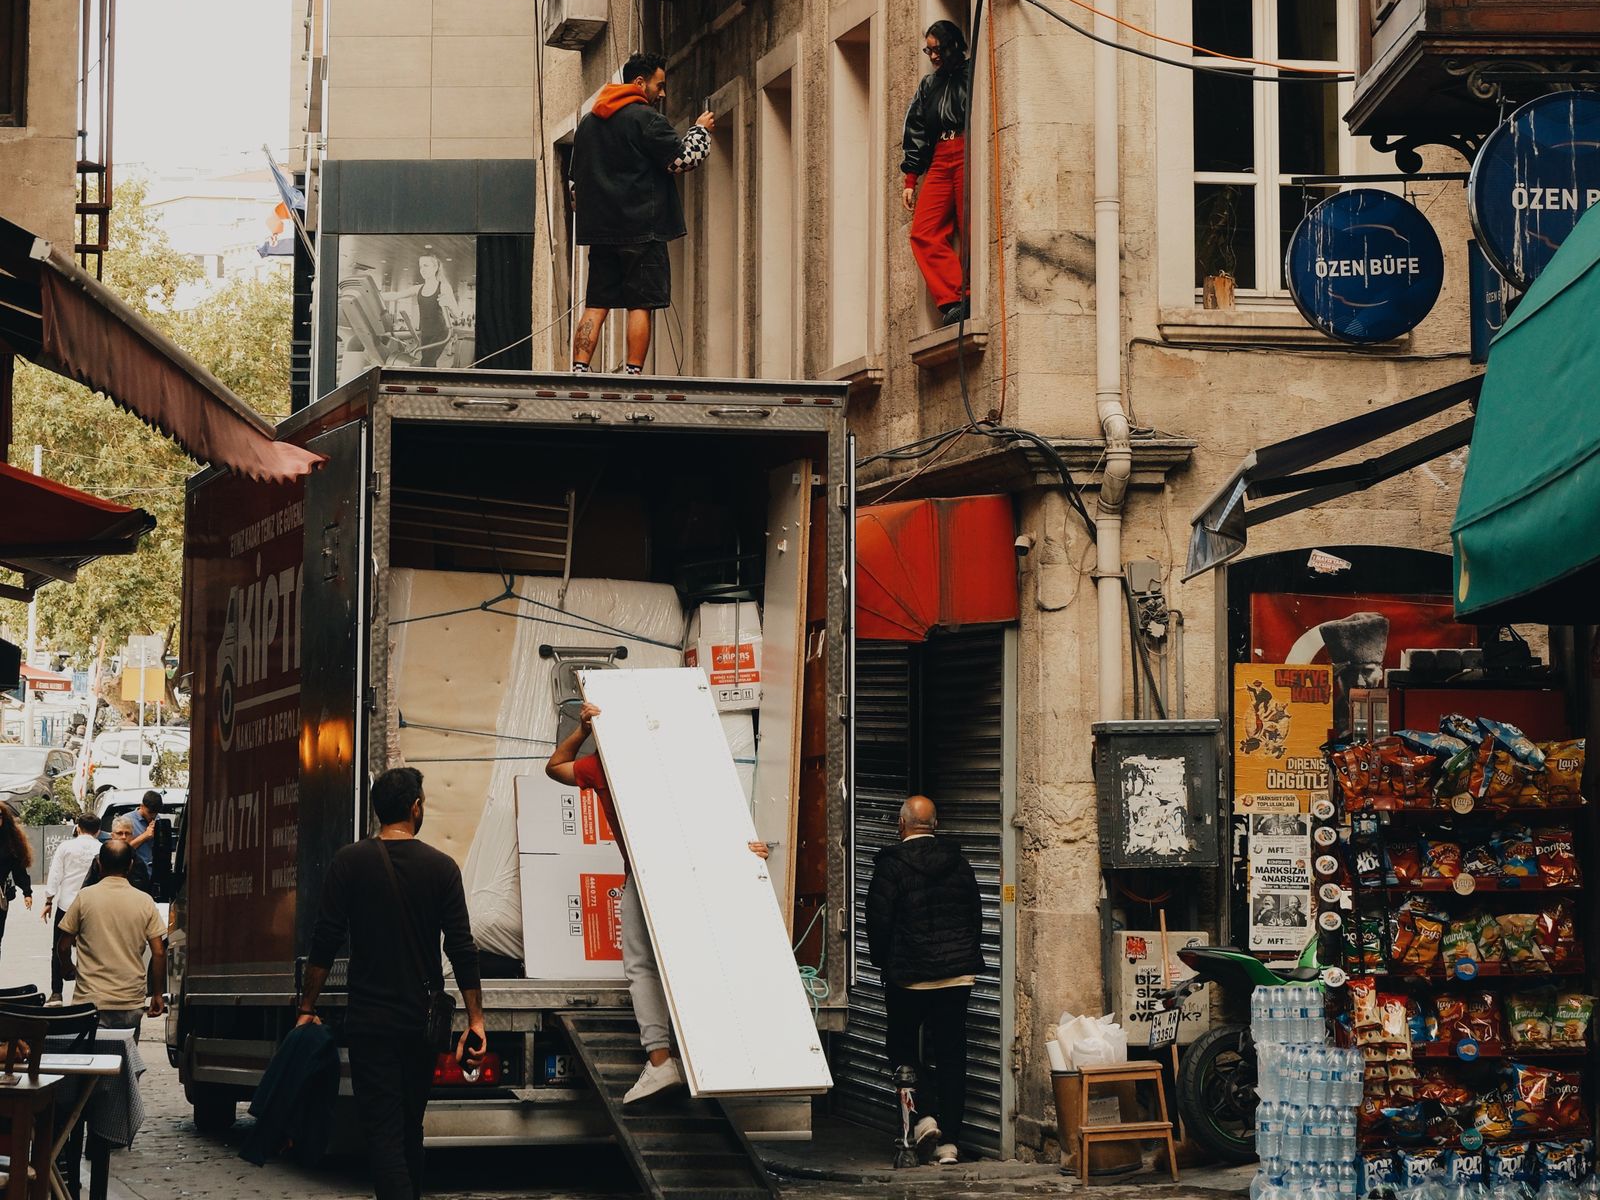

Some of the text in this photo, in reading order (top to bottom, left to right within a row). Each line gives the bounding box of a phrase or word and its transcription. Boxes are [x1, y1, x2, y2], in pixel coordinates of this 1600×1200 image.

[1512, 183, 1578, 210] ÖZEN
[1316, 255, 1420, 279] ÖZEN BÜFE
[1267, 769, 1329, 789] ÖRGÜTLE
[203, 790, 259, 855] 444 0 771
[1135, 971, 1161, 985] BİZ
[1137, 985, 1166, 998] SİZ
[1136, 1000, 1156, 1010] NE
[1153, 1011, 1177, 1028] 34 RR
[1157, 1027, 1173, 1041] 3350
